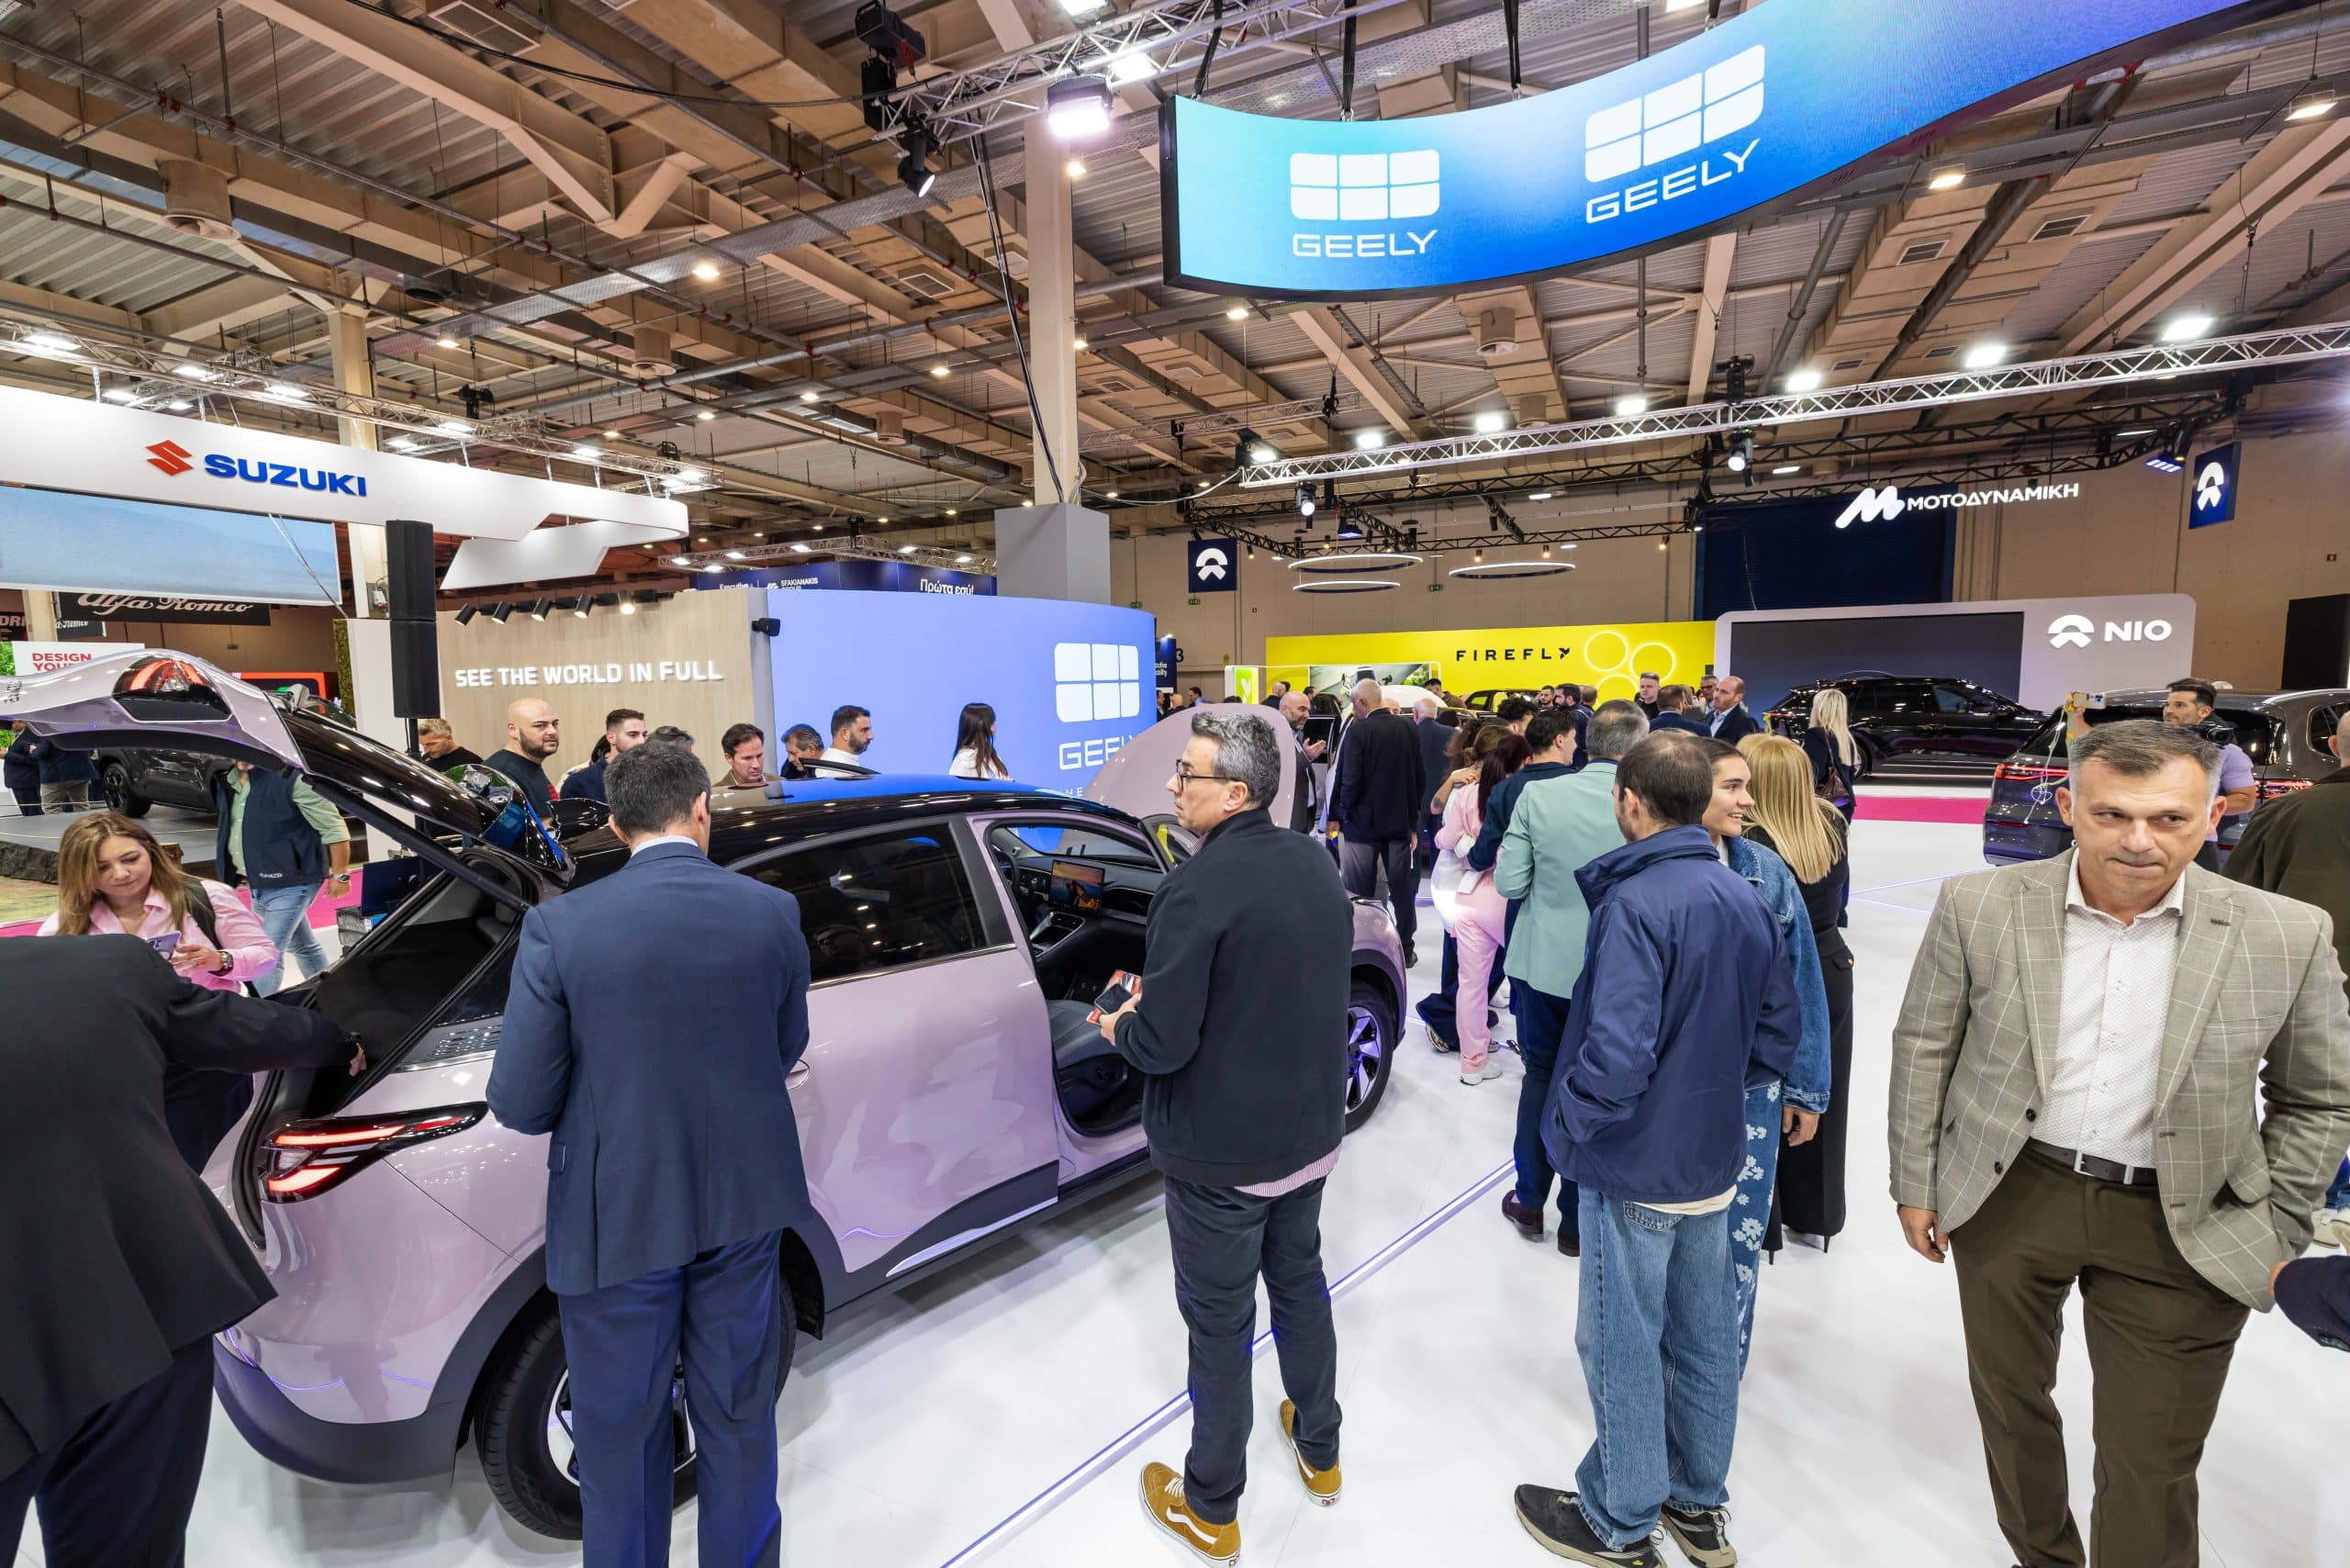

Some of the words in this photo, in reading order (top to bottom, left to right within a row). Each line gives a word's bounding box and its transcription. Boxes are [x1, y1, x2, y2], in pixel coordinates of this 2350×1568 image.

[1585, 137, 1761, 224] GEELY
[1292, 229, 1438, 258] GEELY
[204, 454, 367, 498] SUZUKI
[2104, 619, 2173, 643] NIO
[31, 653, 92, 662] DESIGN
[33, 663, 74, 672] YO
[454, 668, 493, 688] SEE
[497, 666, 537, 686] THE
[543, 664, 621, 685] WORLD
[629, 663, 653, 682] IN
[659, 660, 723, 681] FULL
[1058, 734, 1133, 770] GEE
